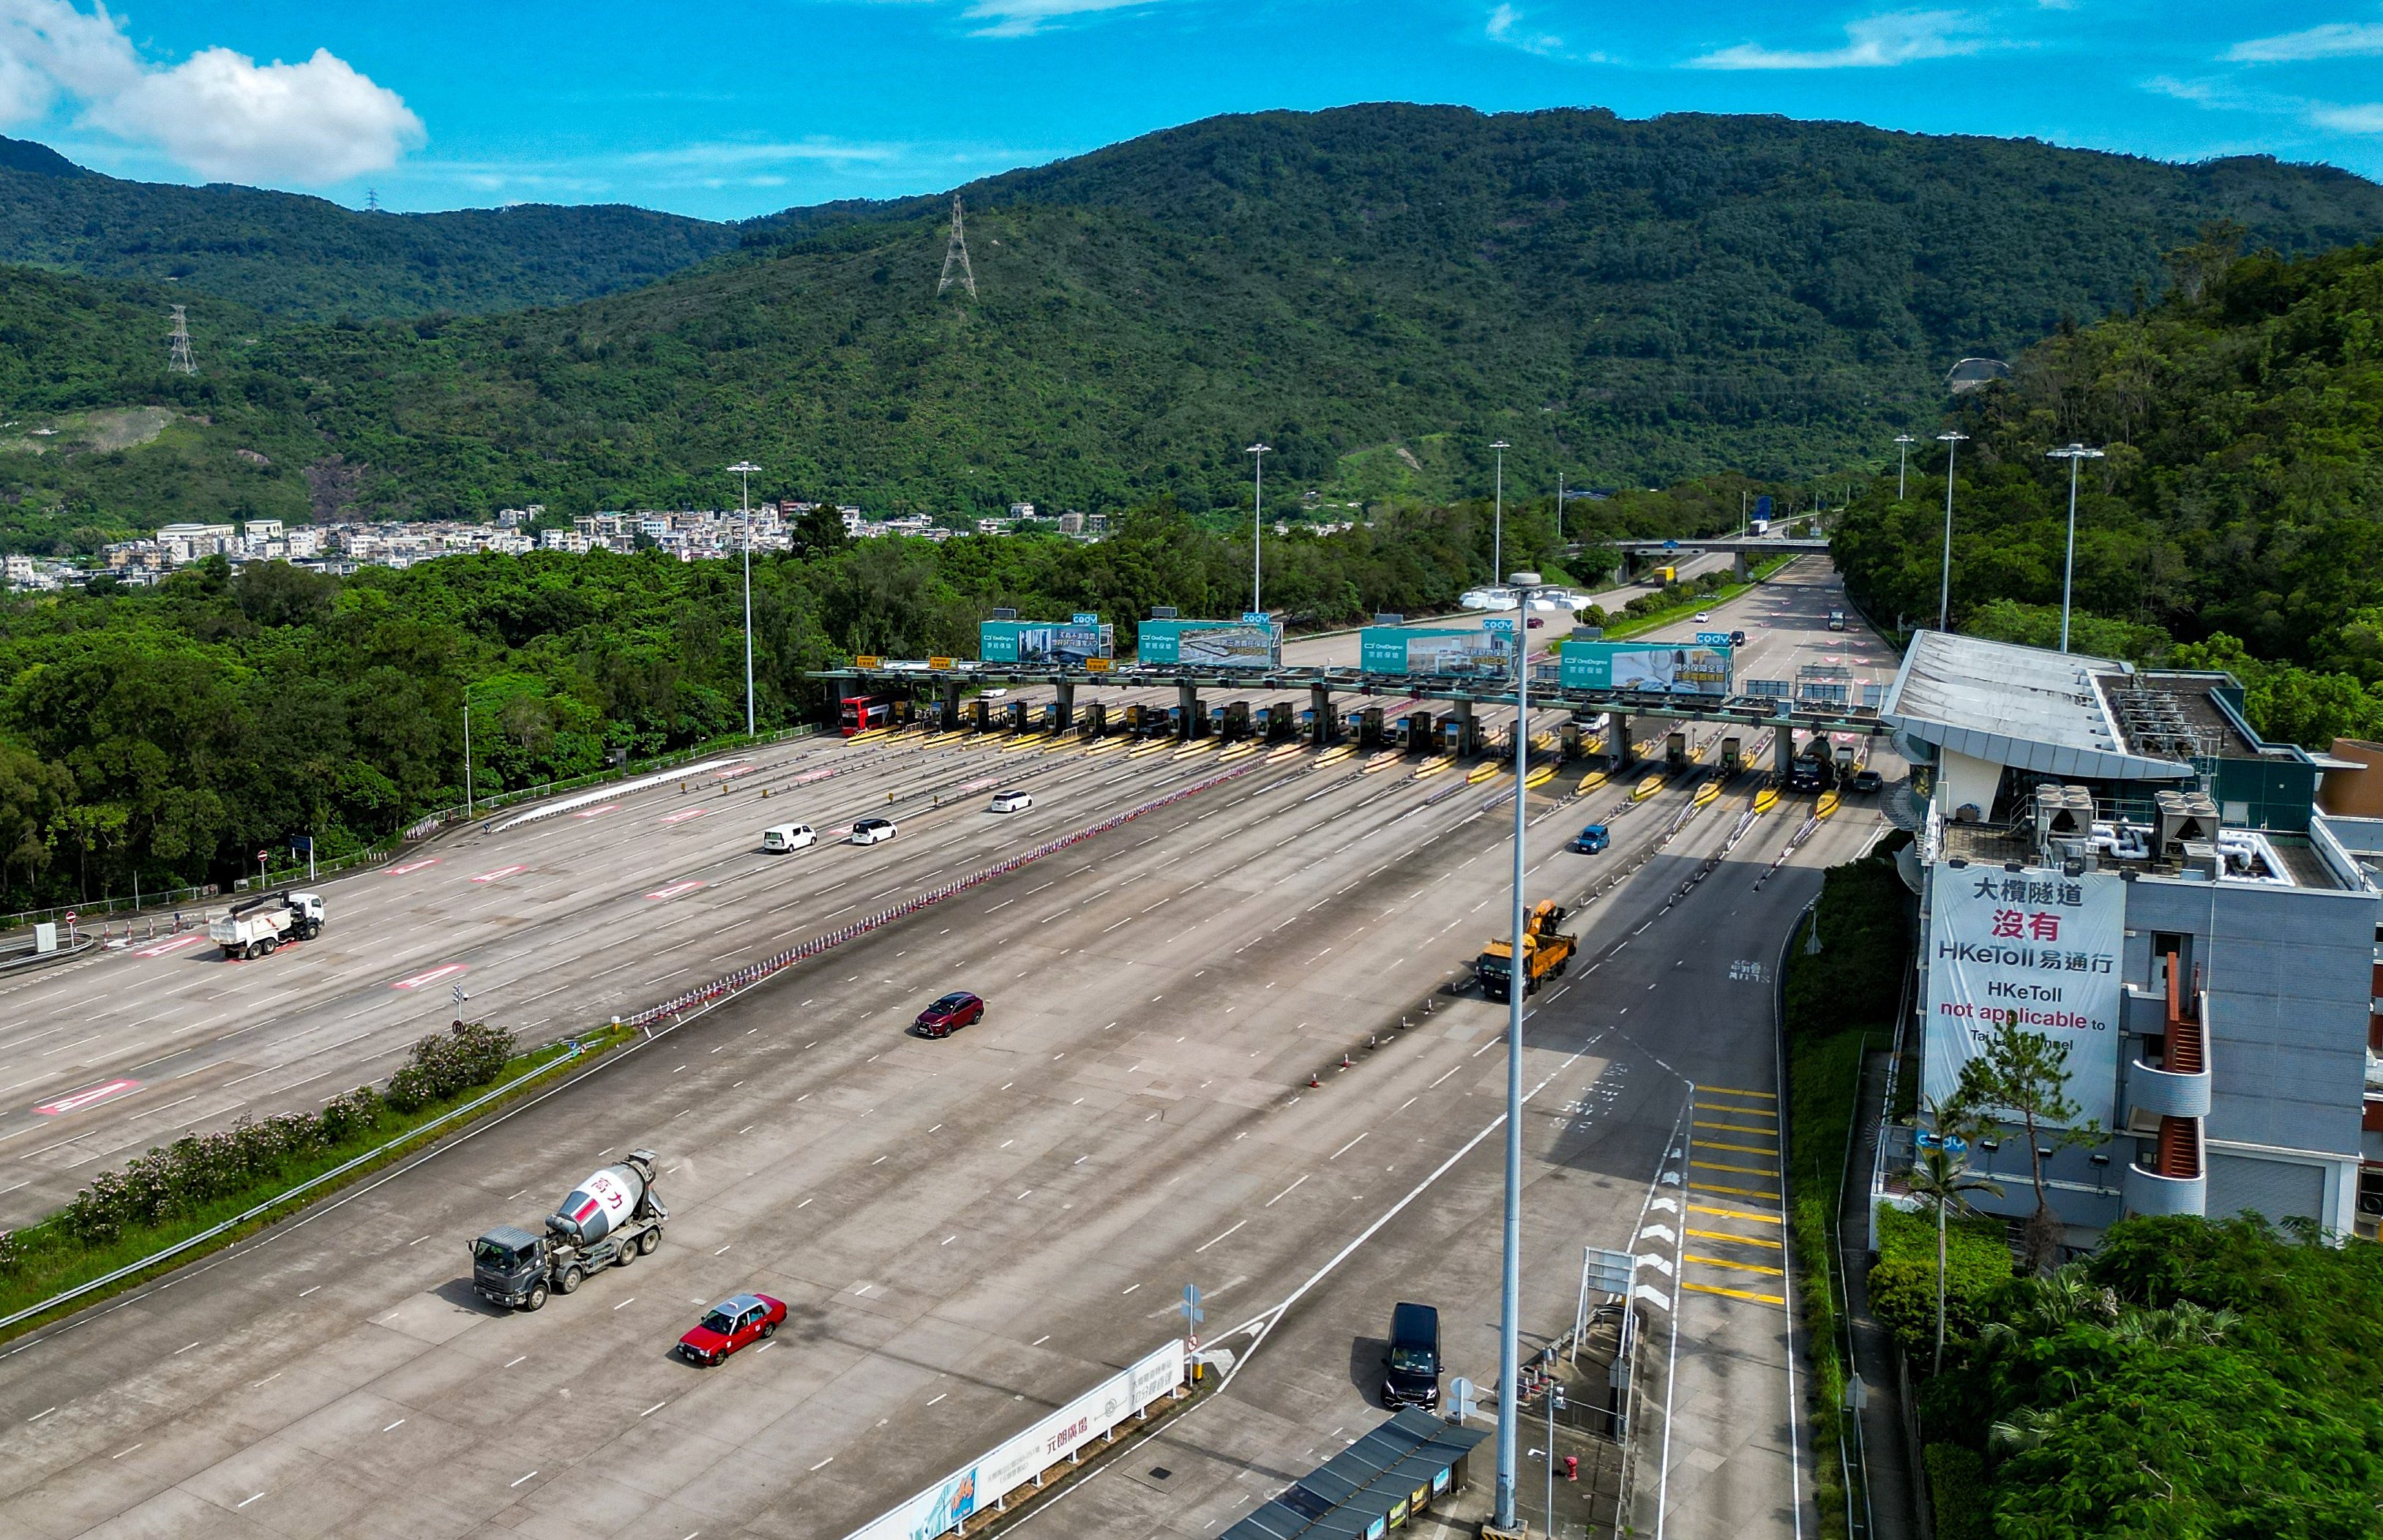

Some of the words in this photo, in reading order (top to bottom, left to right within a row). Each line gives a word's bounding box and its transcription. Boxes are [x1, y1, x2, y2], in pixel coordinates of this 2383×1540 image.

[1073, 615, 1097, 624] cody
[1243, 614, 1268, 624] cody
[1483, 620, 1513, 629] cody
[1696, 634, 1729, 643] cody
[1973, 877, 2083, 907] 大欖隧道
[1991, 909, 2062, 942] 沒有
[1939, 941, 2035, 968] HKeToll
[2038, 950, 2114, 974] 易通行
[1987, 981, 2062, 1003] HKeToll
[1940, 1002, 1974, 1018] not
[1979, 1006, 2087, 1029] applicable
[2091, 1019, 2106, 1031] to
[1970, 1029, 1989, 1042] Tai
[1918, 1135, 1966, 1150] cdy
[591, 1177, 623, 1210] 高力
